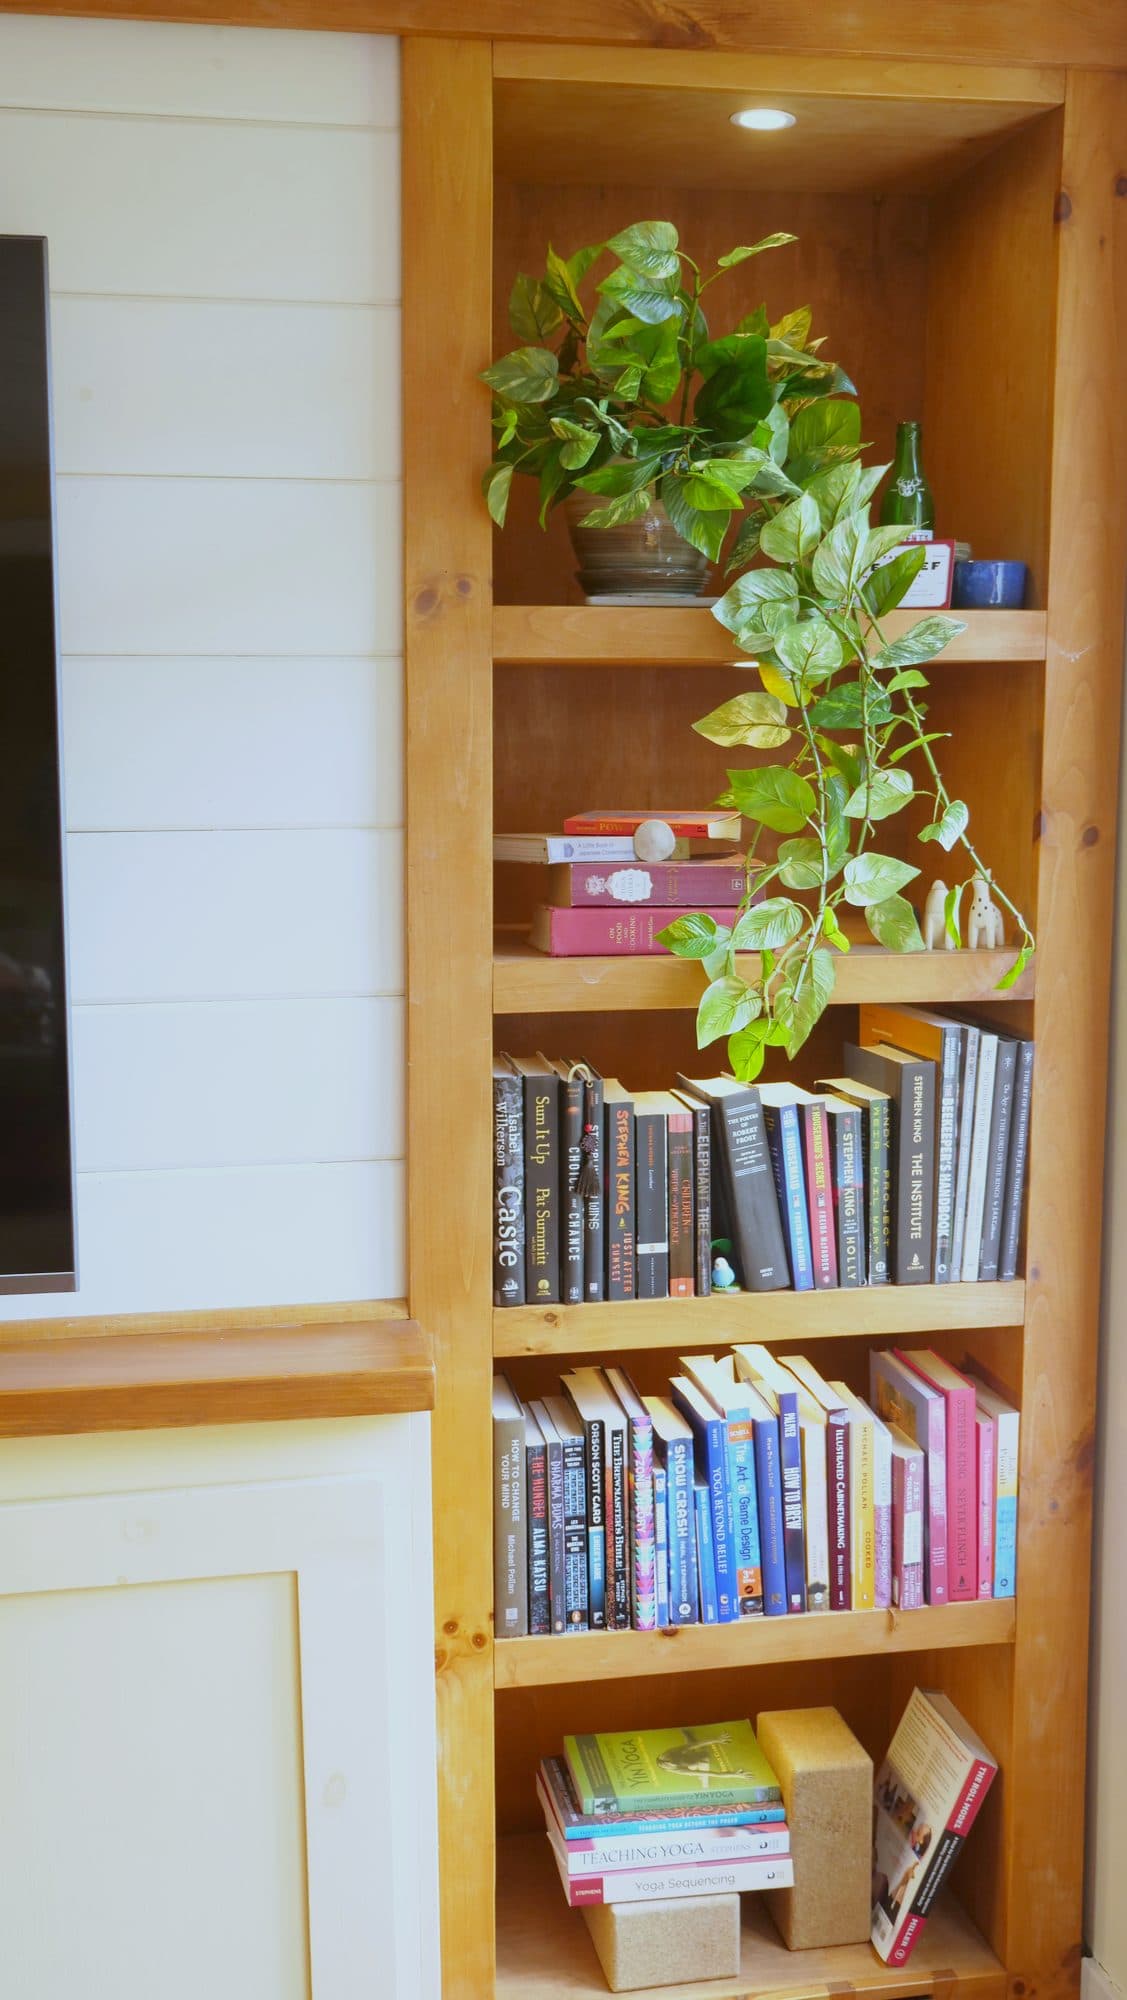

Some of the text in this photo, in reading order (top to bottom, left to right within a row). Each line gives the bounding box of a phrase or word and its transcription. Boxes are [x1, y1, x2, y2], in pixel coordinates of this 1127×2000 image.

[1021, 1098, 1028, 1107] OF
[1023, 1069, 1031, 1083] THE
[496, 1101, 508, 1167] Wilkerson
[507, 1113, 520, 1153] Isabel
[530, 1095, 550, 1164] Sum It Up
[732, 1126, 758, 1138] ROBERT
[810, 1111, 823, 1159] HOUSEMAID'S
[872, 1105, 880, 1150] WEIR
[882, 1106, 890, 1149] ANDY
[912, 1075, 923, 1143] STEPHEN KING
[940, 1097, 955, 1172] BEEKEEPER'S
[615, 1109, 632, 1215] STEPHEN KING
[735, 1134, 757, 1145] FROST
[786, 1134, 800, 1190] HOUSEMAID
[993, 1118, 1007, 1198] THE LORD OF THE RINGS
[697, 1135, 710, 1202] ELEPHANT
[814, 1161, 826, 1189] SECRET
[842, 1132, 855, 1217] STEPHEN KING
[910, 1152, 923, 1240] THE INSTITUTE
[1012, 1177, 1021, 1206] TOLKIEN
[496, 1185, 522, 1267] Caste
[535, 1187, 551, 1266] Pat Summitt
[588, 1201, 600, 1230] WINS
[681, 1178, 692, 1226] CHILDREN
[697, 1206, 710, 1236] TREE
[872, 1166, 880, 1255] HAIL MARY
[882, 1169, 890, 1248] PROJECT
[938, 1173, 952, 1238] HANDBOOK
[568, 1212, 580, 1262] CHANCE
[611, 1242, 621, 1282] SUNSET
[623, 1231, 632, 1294] JUST AFTER
[846, 1236, 857, 1280] HOLLY
[783, 1412, 797, 1438] PALMER
[956, 1399, 967, 1480] STEPHEN KING
[511, 1439, 520, 1522] HOW TO CHANGE
[591, 1423, 602, 1525] ORSON SCOTT CARD
[734, 1444, 747, 1463] The
[736, 1464, 749, 1483] Art
[501, 1454, 510, 1509] YOUR MIND
[532, 1454, 546, 1519] THE HUNGER
[550, 1459, 563, 1530] DHARMA BUMS
[612, 1434, 624, 1569] THE BREWMASTER'S BIBLE
[674, 1443, 689, 1538] SNOW CRASH
[783, 1467, 802, 1531] HOW TO BREW
[835, 1428, 846, 1550] ILLUSTRATED CABINETMAKING
[712, 1465, 727, 1575] YOGA BEYOND BELIEF
[738, 1496, 751, 1526] Game
[956, 1488, 968, 1567] NEVER FLINCH
[507, 1534, 517, 1595] Michael Pollan
[532, 1527, 547, 1593] ALMA KATSU
[738, 1528, 753, 1561] Design
[864, 1530, 872, 1569] COOKED
[680, 1559, 688, 1602] STEPHENSON
[620, 1739, 643, 1770] YOGA
[626, 1768, 650, 1788] YIN
[953, 1766, 988, 1830] THE ROLL MODEL
[580, 1842, 705, 1865] TEACHING YOGA
[575, 1888, 602, 1896] STEPHENS
[634, 1874, 736, 1893] Yoga Sequencing
[900, 1917, 920, 1947] MILLER
